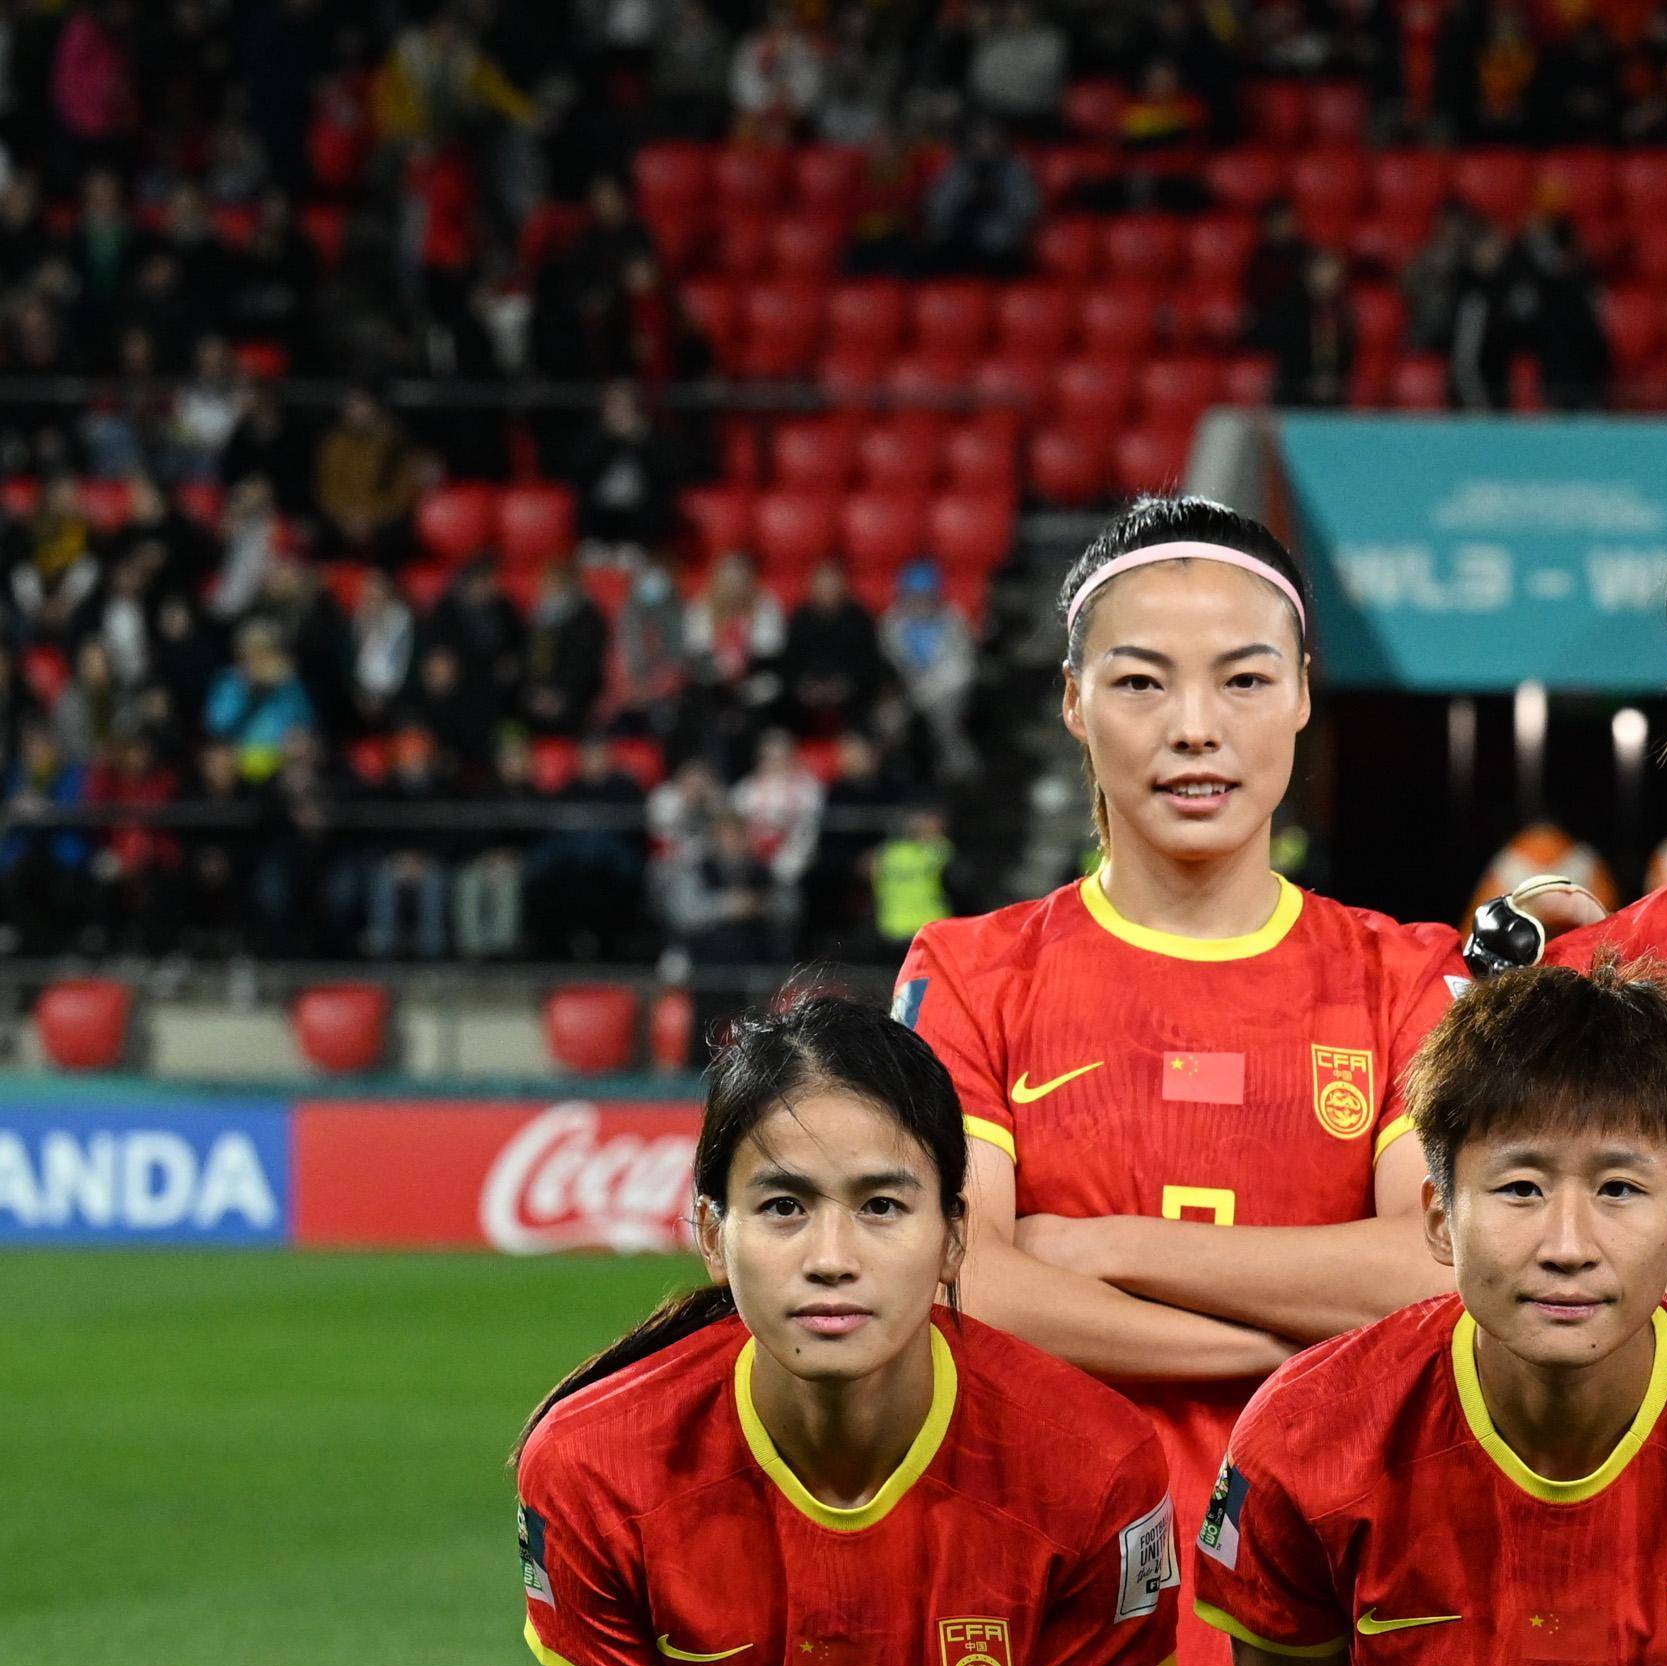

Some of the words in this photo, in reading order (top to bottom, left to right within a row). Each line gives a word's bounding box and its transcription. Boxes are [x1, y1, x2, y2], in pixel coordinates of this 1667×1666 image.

[1317, 1051, 1367, 1073] CFA
[1140, 1535, 1165, 1567] UNIT
[946, 1624, 1002, 1642] CFA
